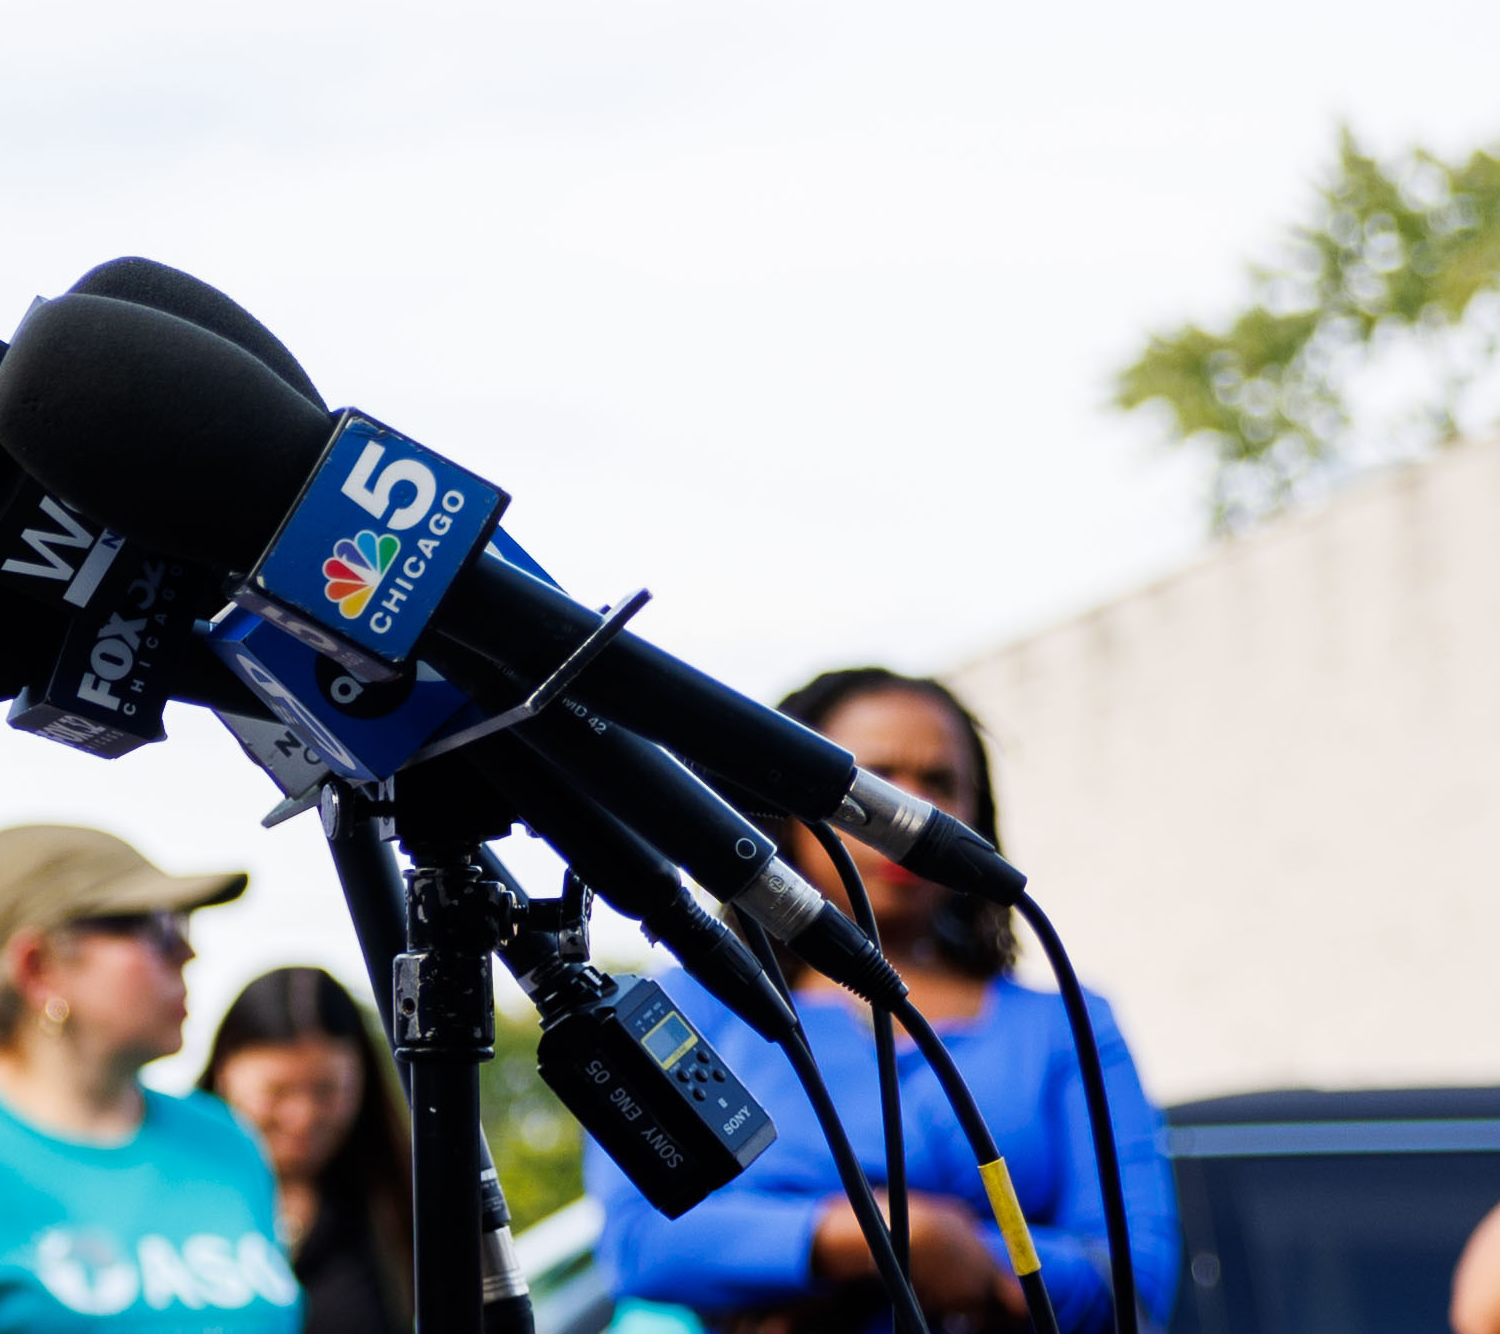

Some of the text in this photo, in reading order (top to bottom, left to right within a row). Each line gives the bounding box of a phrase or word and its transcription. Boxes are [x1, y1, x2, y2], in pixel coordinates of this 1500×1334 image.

[341, 440, 436, 531] 5
[369, 490, 465, 634] CHICAGO
[587, 717, 607, 735] 42
[585, 1059, 684, 1168] SONY ENG 05
[723, 1105, 751, 1136] SONY
